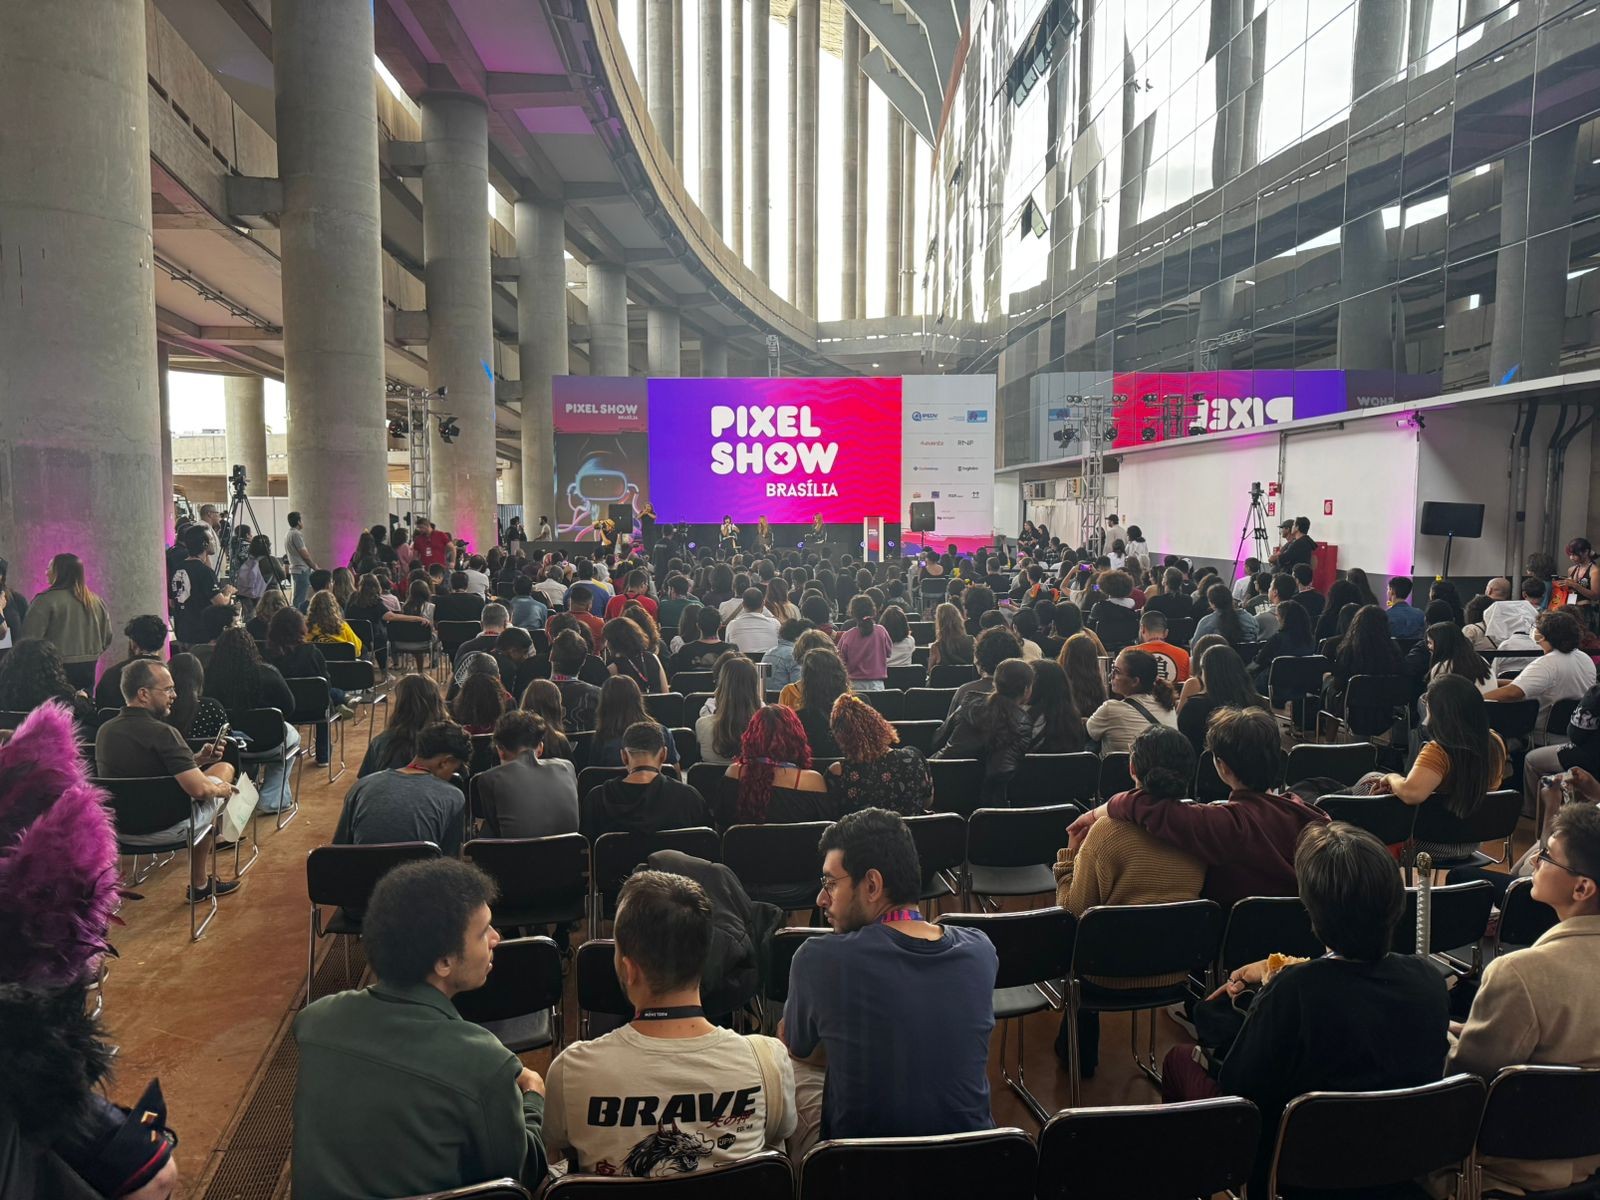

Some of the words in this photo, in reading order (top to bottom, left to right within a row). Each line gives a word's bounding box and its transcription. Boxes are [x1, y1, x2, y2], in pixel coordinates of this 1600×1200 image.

[565, 403, 599, 414] PIXEL
[599, 404, 638, 415] SHOW
[710, 405, 822, 438] PIXEL
[710, 441, 839, 475] SHOW
[766, 479, 839, 497] BRASÍLIA
[587, 1085, 762, 1127] BRAVE
